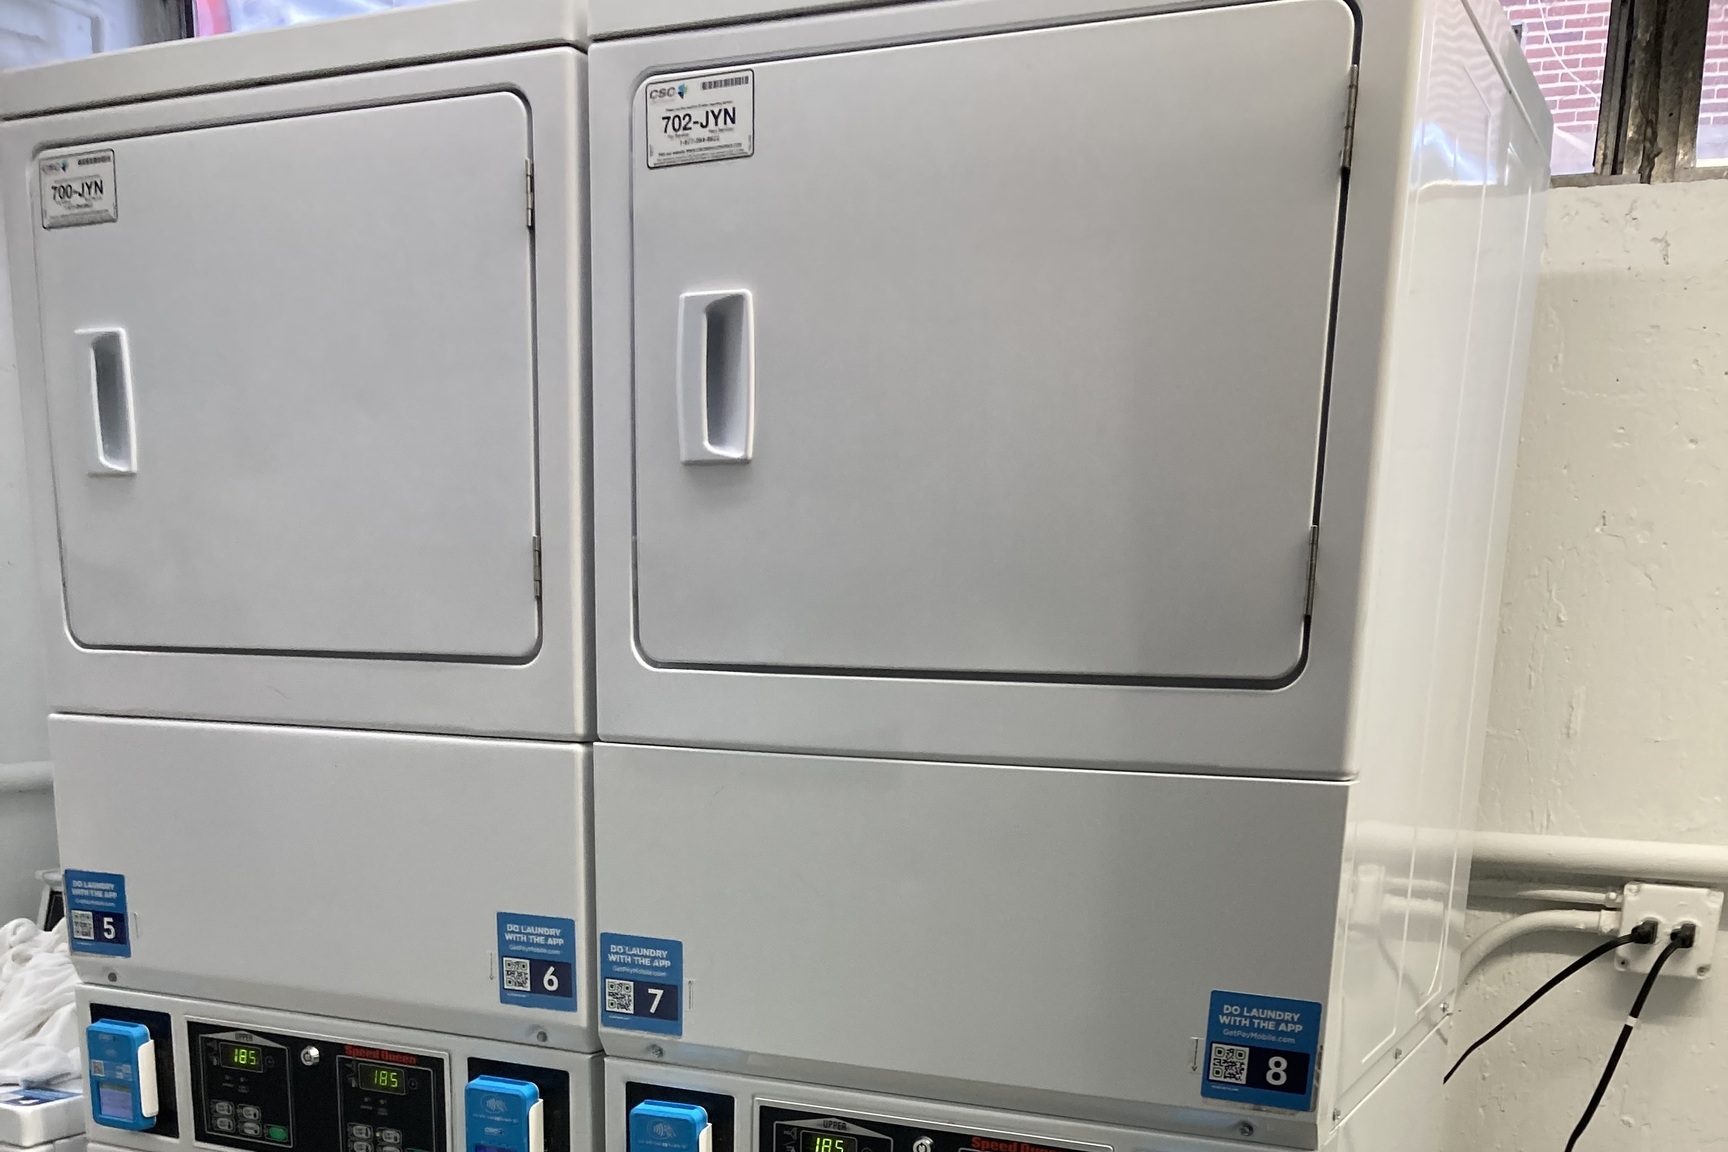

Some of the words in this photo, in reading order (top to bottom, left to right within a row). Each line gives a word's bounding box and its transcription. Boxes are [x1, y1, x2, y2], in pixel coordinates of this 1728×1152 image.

[649, 86, 676, 99] CSC
[662, 107, 736, 133] 702-JYN
[51, 180, 104, 200] 700-JYN
[103, 917, 116, 939] 5
[507, 923, 519, 932] DO
[521, 925, 561, 936] LAUNDRY
[504, 933, 527, 943] WITH
[528, 935, 545, 944] THE
[547, 937, 564, 946] APP
[610, 944, 623, 953] DO
[625, 946, 668, 958] LAUNDRY
[608, 954, 631, 964] WITH
[633, 956, 650, 966] THE
[652, 958, 671, 968] APP
[543, 966, 559, 991] 6
[647, 988, 664, 1014] 7
[1223, 1004, 1240, 1014] DO
[1243, 1007, 1300, 1022] LAUNDRY
[1218, 1014, 1250, 1027] WITH
[1253, 1019, 1276, 1030] THE
[1278, 1022, 1303, 1033] APP
[1223, 1028, 1296, 1044] GetPayMobile.com
[234, 1048, 256, 1065] 185
[374, 1070, 398, 1088] 185
[1265, 1056, 1288, 1086] 8
[823, 1120, 847, 1131] UPPER
[971, 1136, 1018, 1152] Speed
